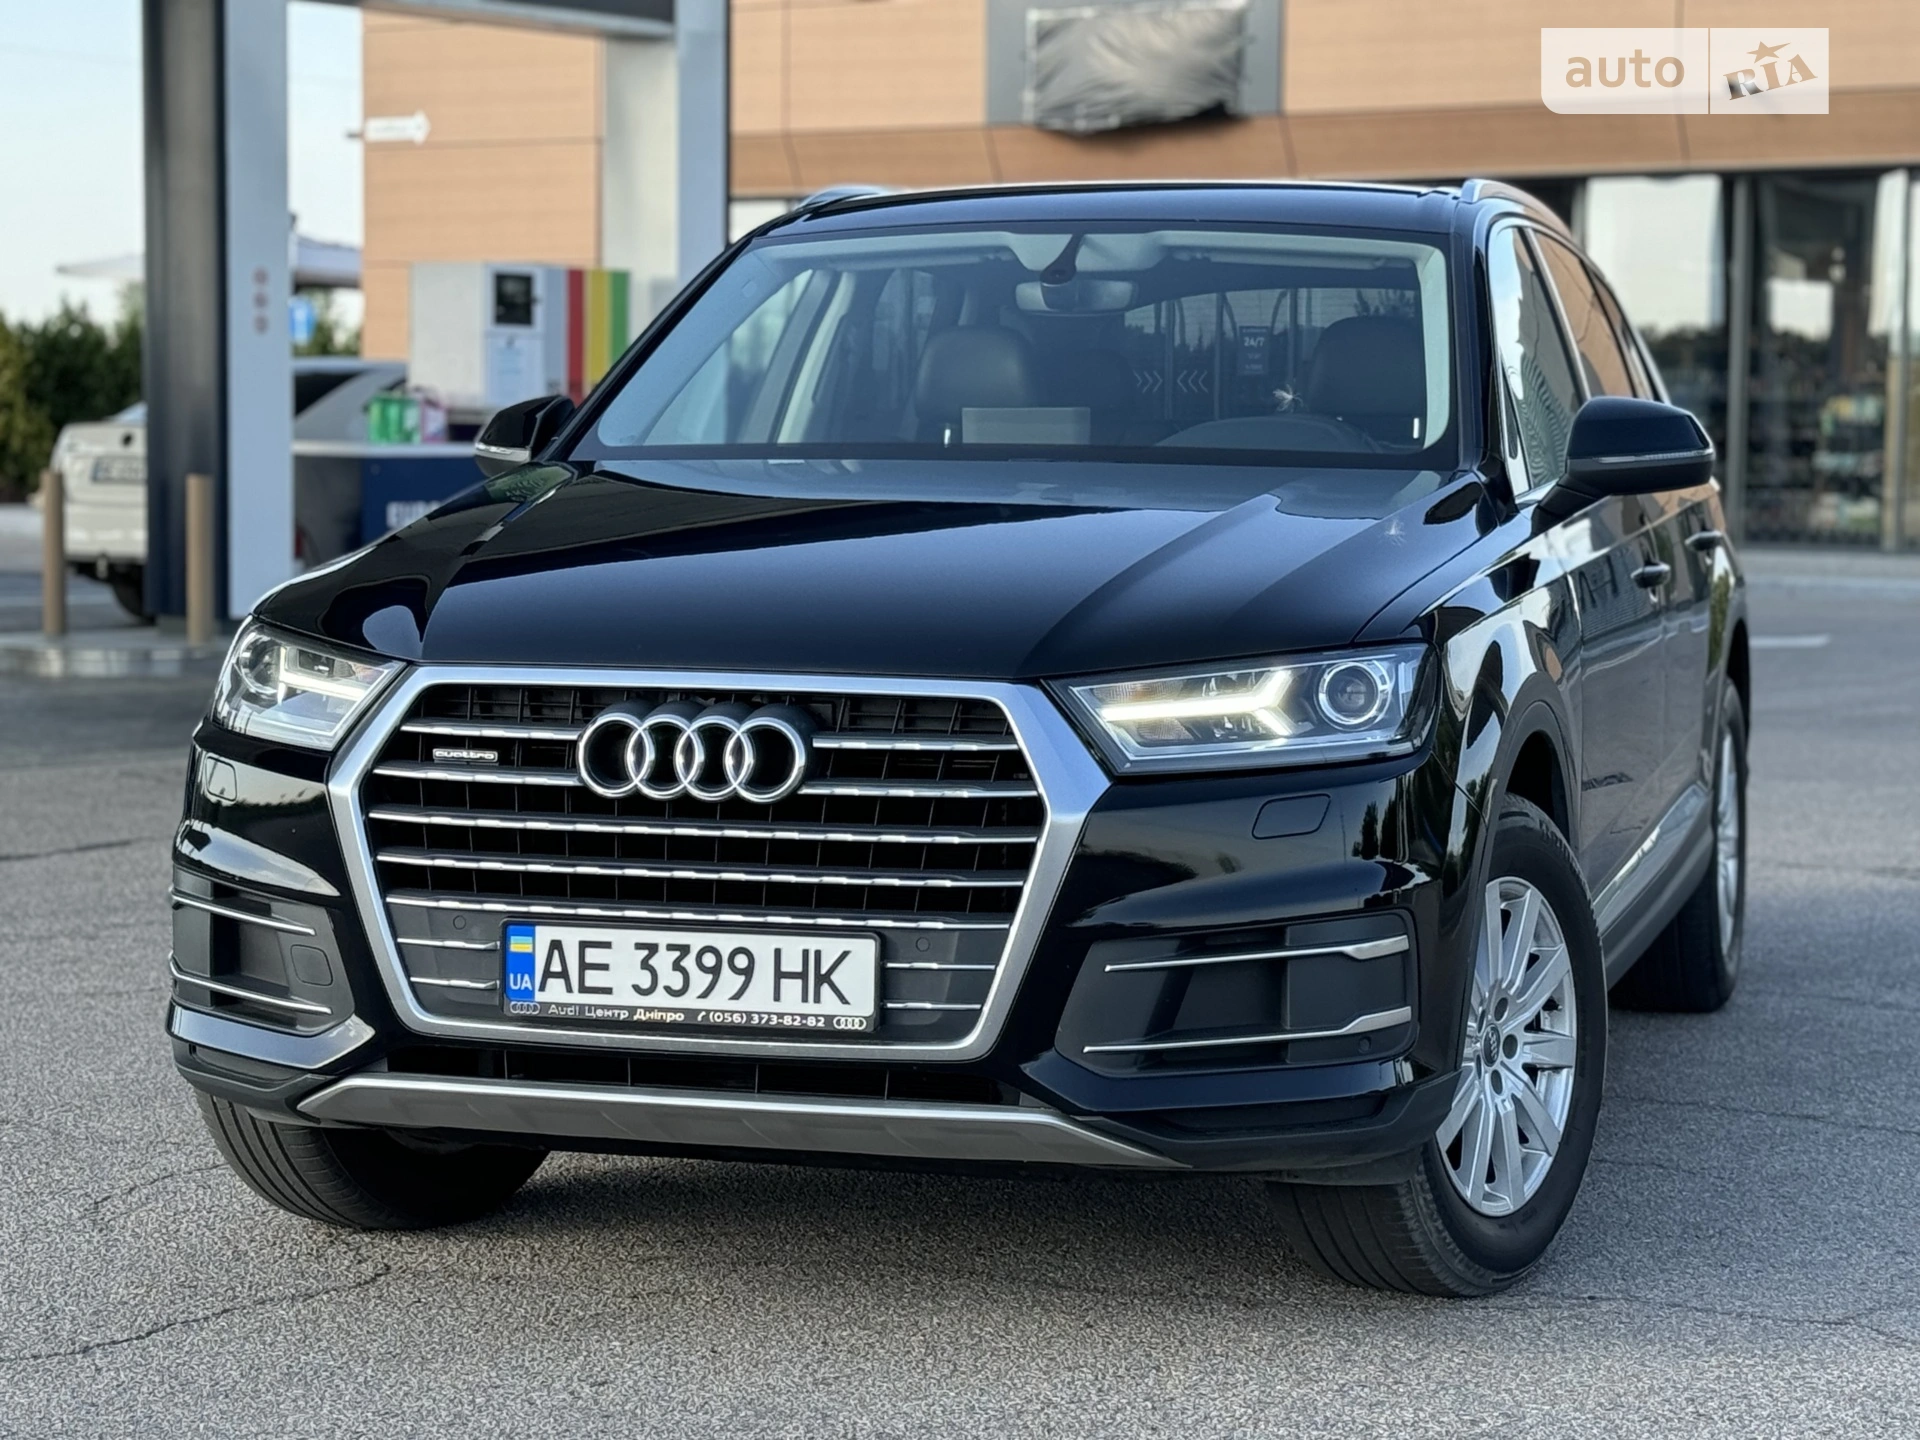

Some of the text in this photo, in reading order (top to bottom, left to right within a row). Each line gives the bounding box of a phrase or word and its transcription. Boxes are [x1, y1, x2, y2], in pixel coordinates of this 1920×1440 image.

[509, 973, 533, 991] UA
[538, 939, 852, 1006] AE 3399 HK
[548, 1004, 826, 1028] Audi Центр Дніпро (056) 373-82-82
